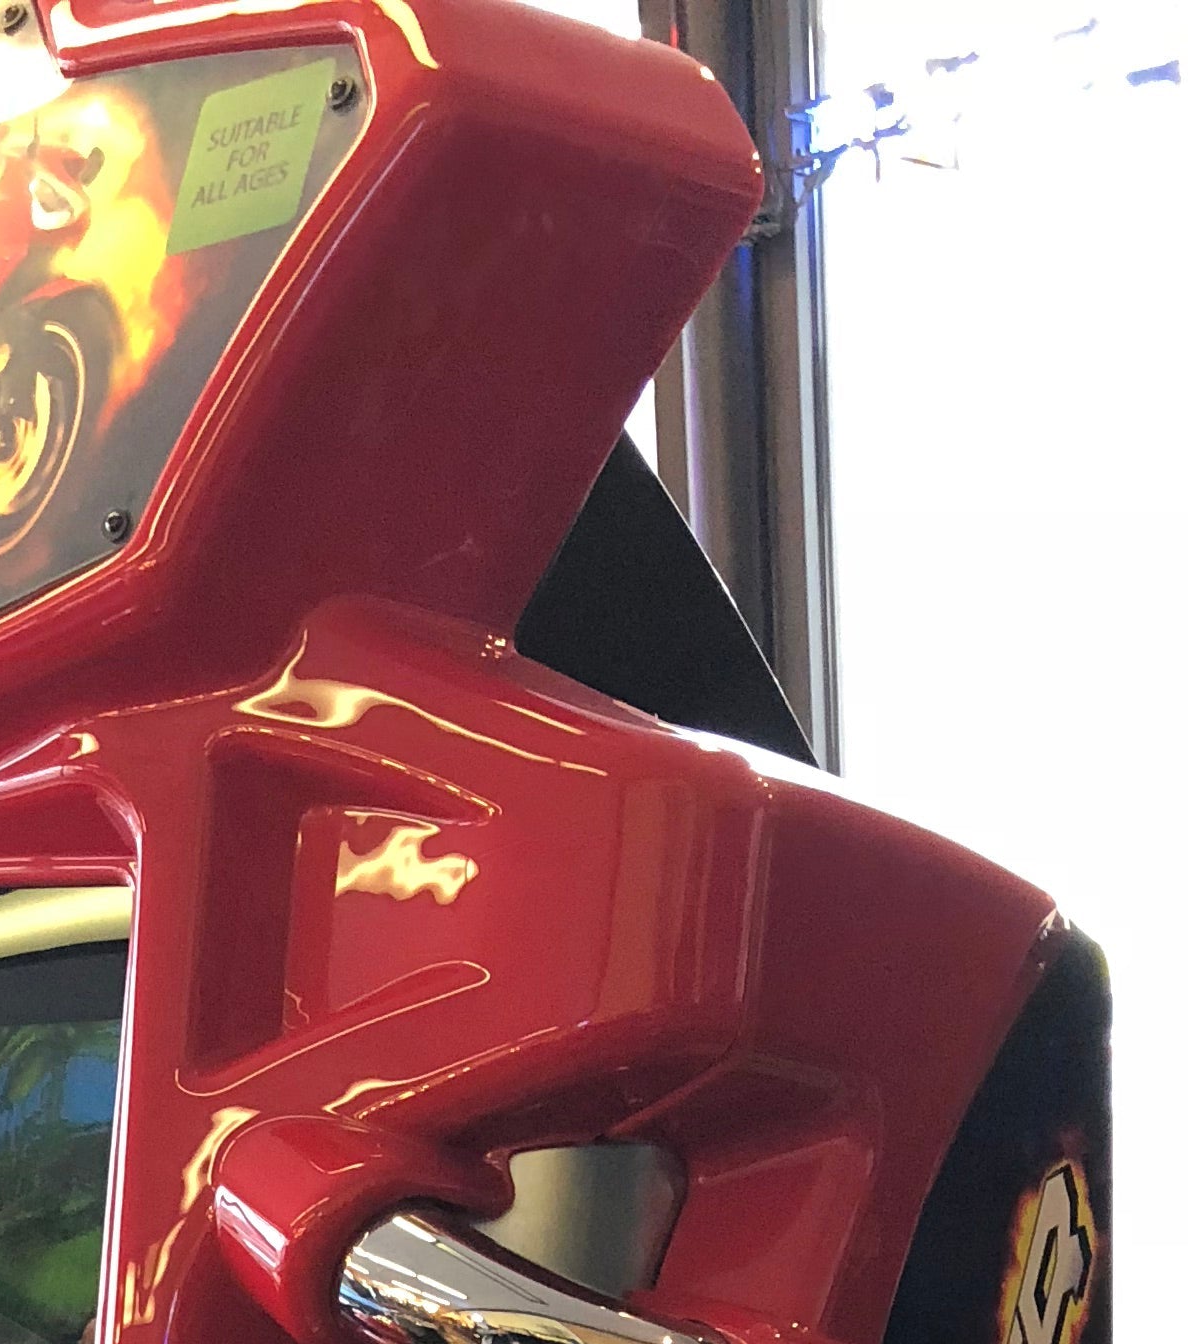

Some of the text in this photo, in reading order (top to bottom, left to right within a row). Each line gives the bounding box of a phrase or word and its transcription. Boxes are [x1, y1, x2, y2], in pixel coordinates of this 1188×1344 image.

[207, 103, 303, 151] SUITABLE
[226, 142, 270, 171] FOR
[191, 161, 289, 208] ALL AGES
